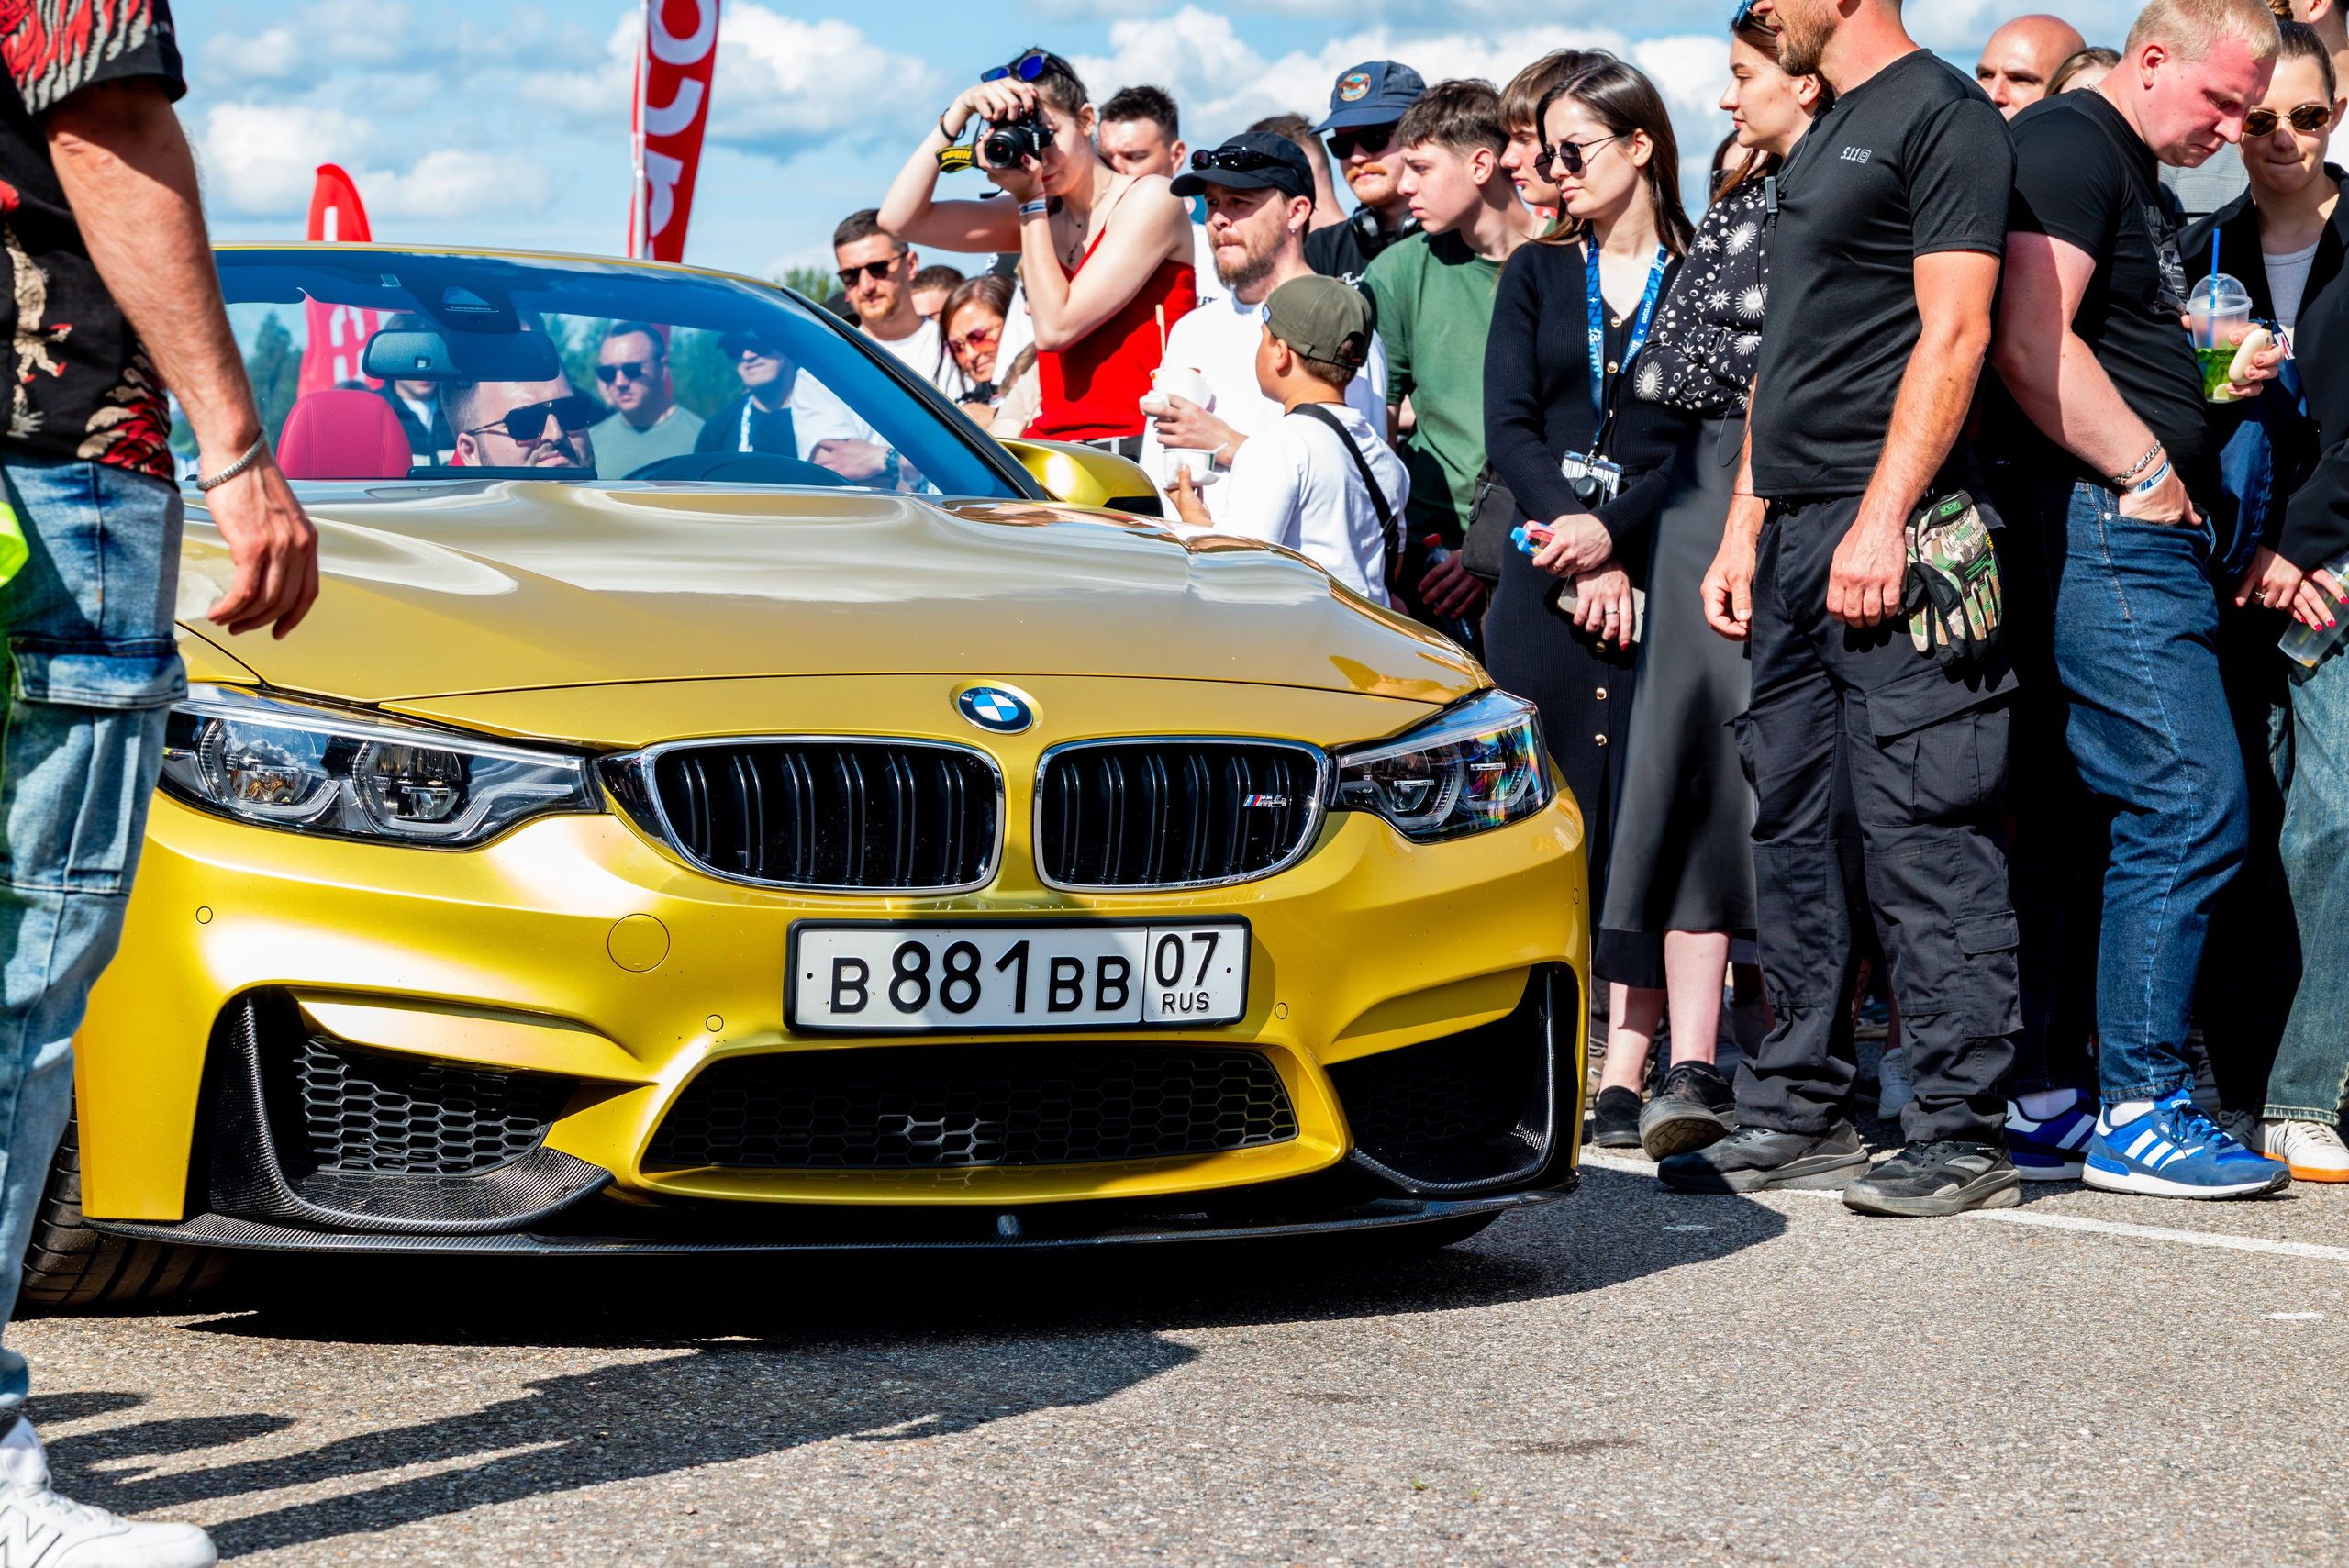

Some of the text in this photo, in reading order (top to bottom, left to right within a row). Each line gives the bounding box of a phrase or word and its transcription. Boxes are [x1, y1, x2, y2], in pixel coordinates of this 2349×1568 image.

[941, 150, 973, 161] Nikon
[961, 687, 1019, 702] BMW
[1154, 931, 1219, 988] 07
[1160, 991, 1209, 1013] RUS
